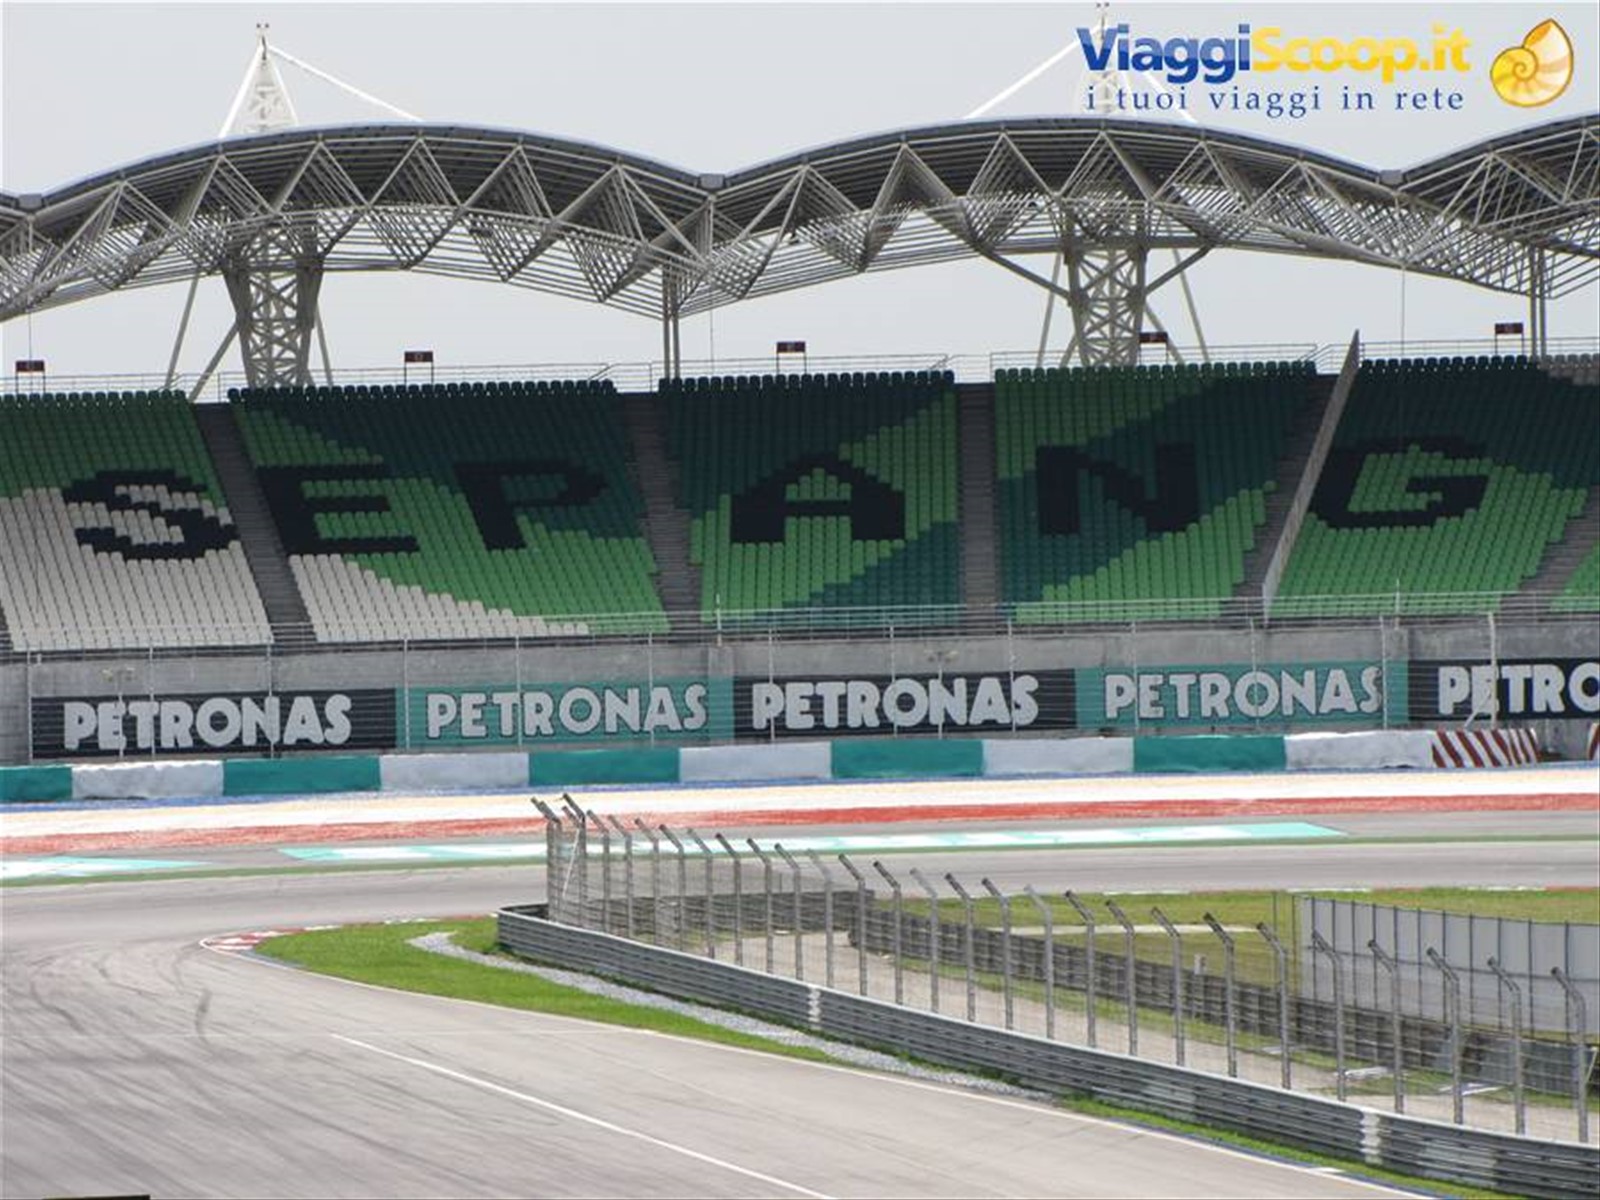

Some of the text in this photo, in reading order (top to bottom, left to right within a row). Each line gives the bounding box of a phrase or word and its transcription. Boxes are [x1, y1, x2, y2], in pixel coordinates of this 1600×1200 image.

[62, 692, 353, 751] PETRONAS
[425, 684, 708, 740] PETRONAS
[751, 674, 1040, 731] PETRONAS
[1104, 664, 1383, 722] PETRONAS
